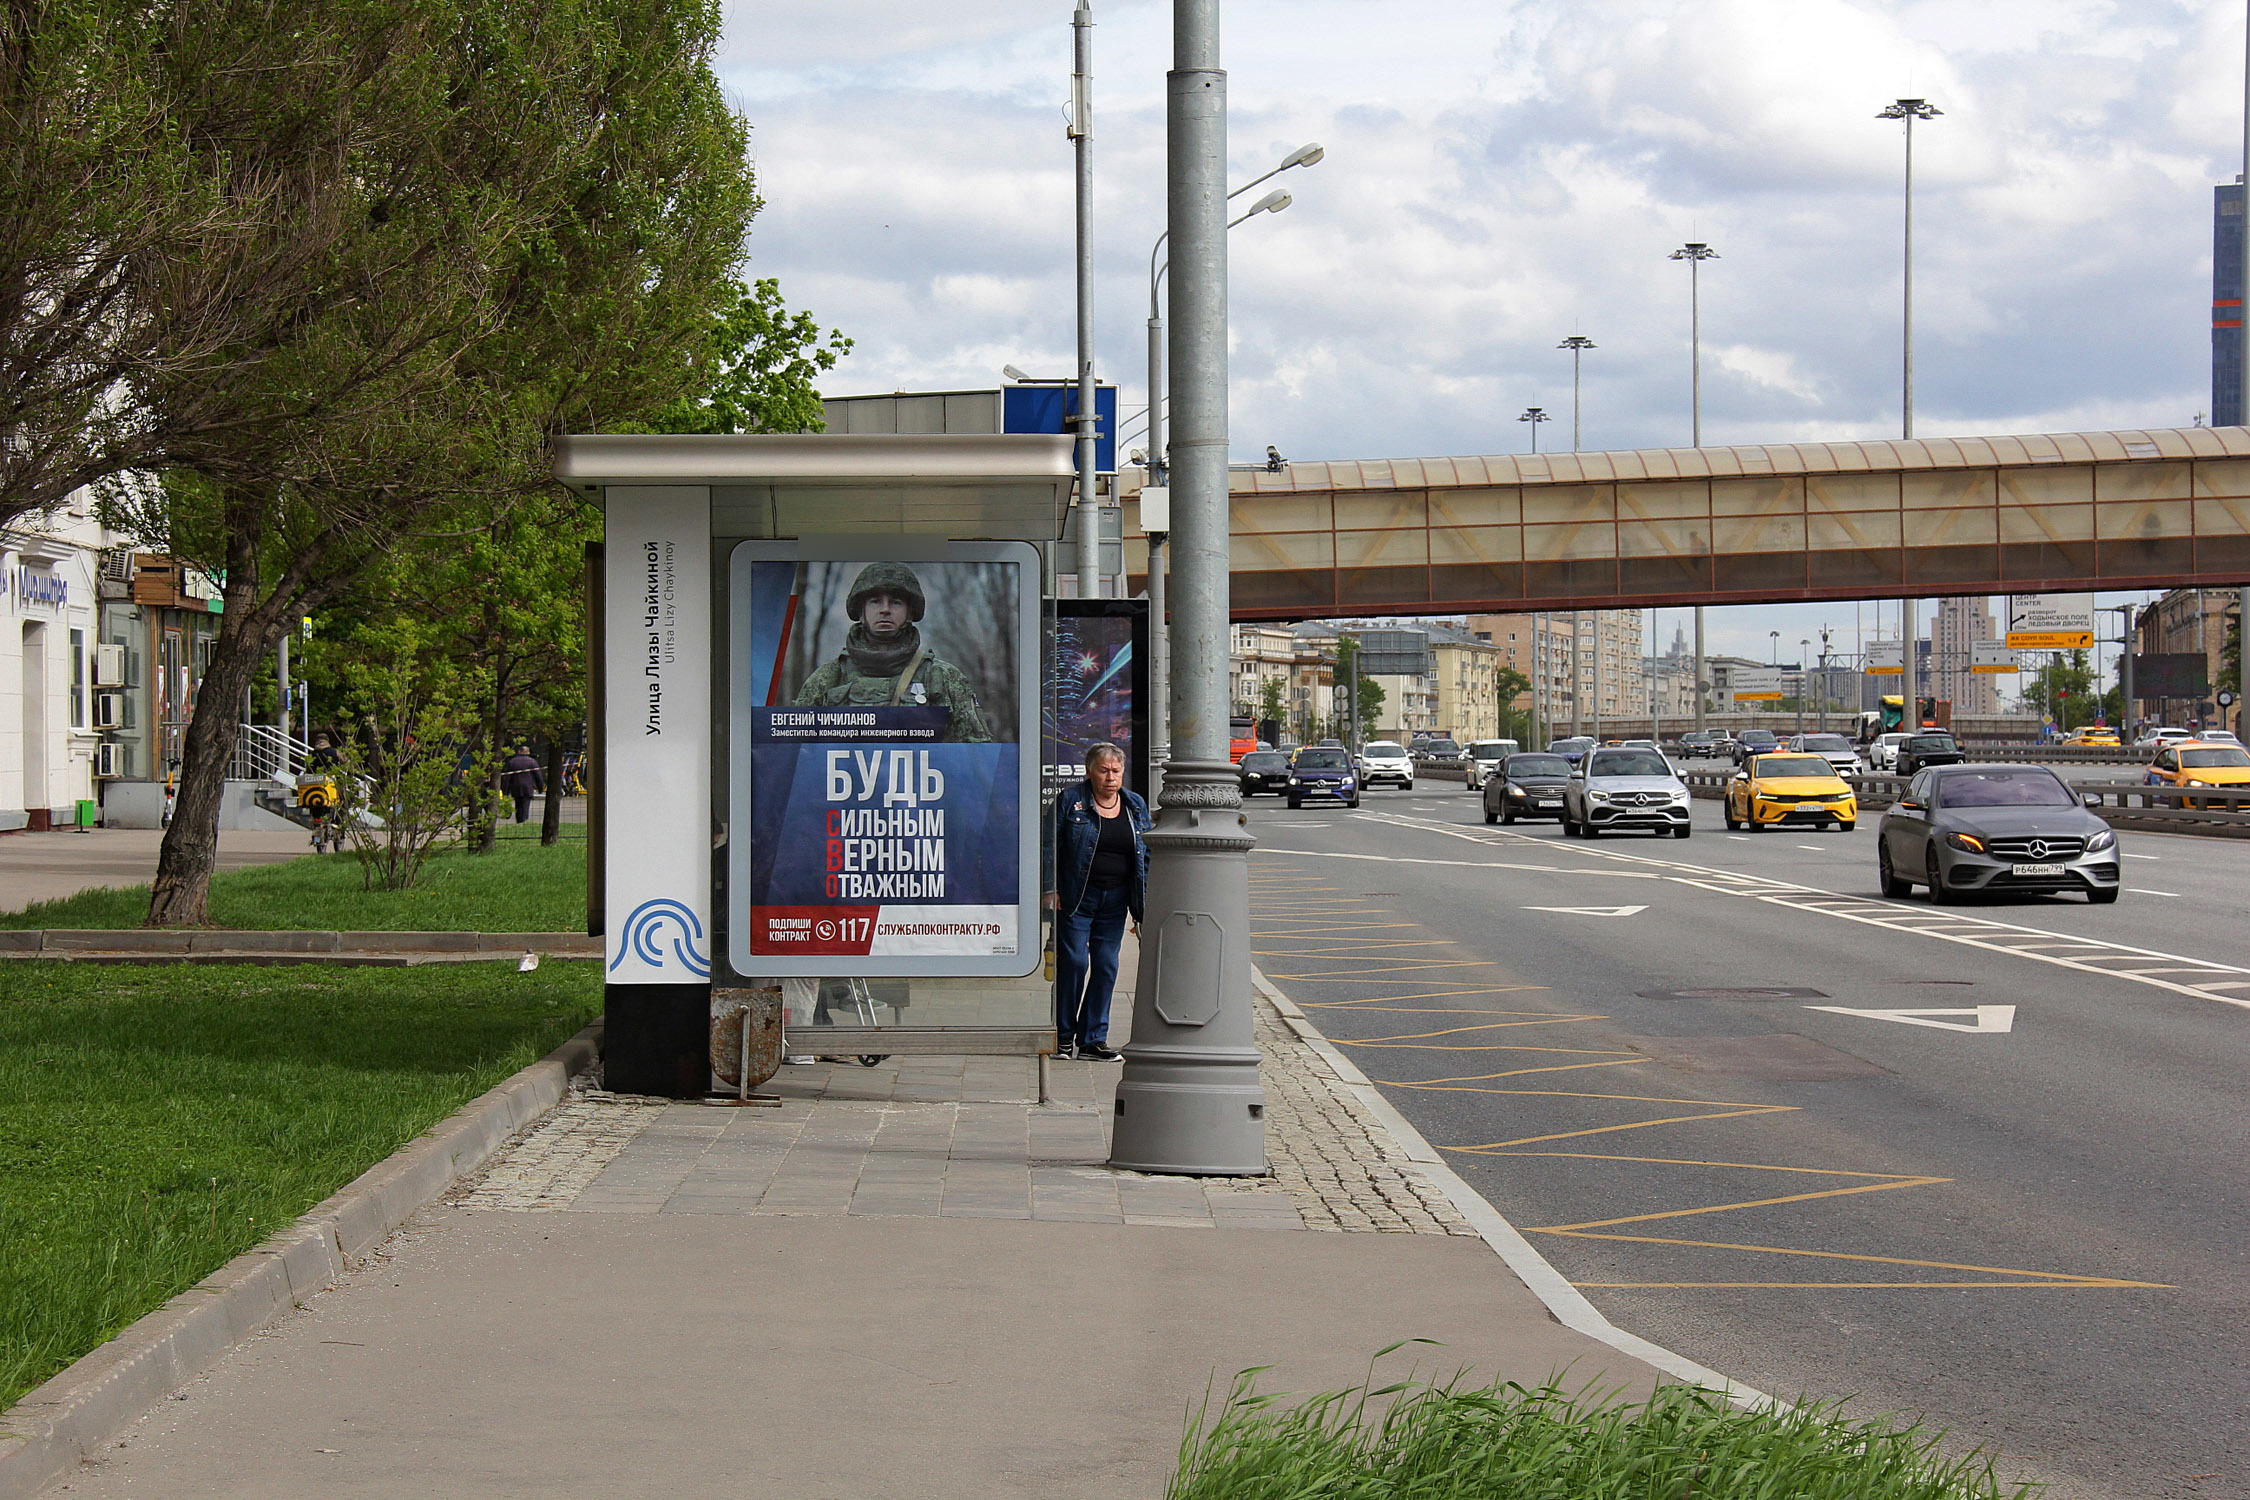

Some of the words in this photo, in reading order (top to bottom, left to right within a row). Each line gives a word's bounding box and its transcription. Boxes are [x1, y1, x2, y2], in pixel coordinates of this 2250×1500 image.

[644, 541, 660, 628] Чайкиной
[664, 540, 676, 601] Chaykinoy
[665, 604, 676, 627] Lizy
[646, 632, 660, 678] Лизы
[665, 630, 675, 664] Ulitsa
[646, 683, 662, 735] Улица
[771, 711, 815, 726] ЕВГЕНИЙ
[817, 713, 876, 726] ЧИЧИЛАНОВ
[771, 728, 818, 737] Заместитель
[819, 729, 859, 738] командира
[860, 729, 908, 738] инженерного
[909, 729, 935, 737] взвода
[826, 750, 945, 808] БУДЬ
[826, 809, 945, 837] СИЛЬНЫМ
[826, 839, 945, 872] ВЕРНЫМ
[825, 873, 945, 898] ОТВАЖНЫМ
[769, 918, 812, 931] ПОДПИШИ
[769, 930, 811, 942] КОНТРАКТ
[838, 917, 871, 942] 117
[878, 923, 1001, 936] СЛУЖБАПОКОНТРАКТУ.РФ
